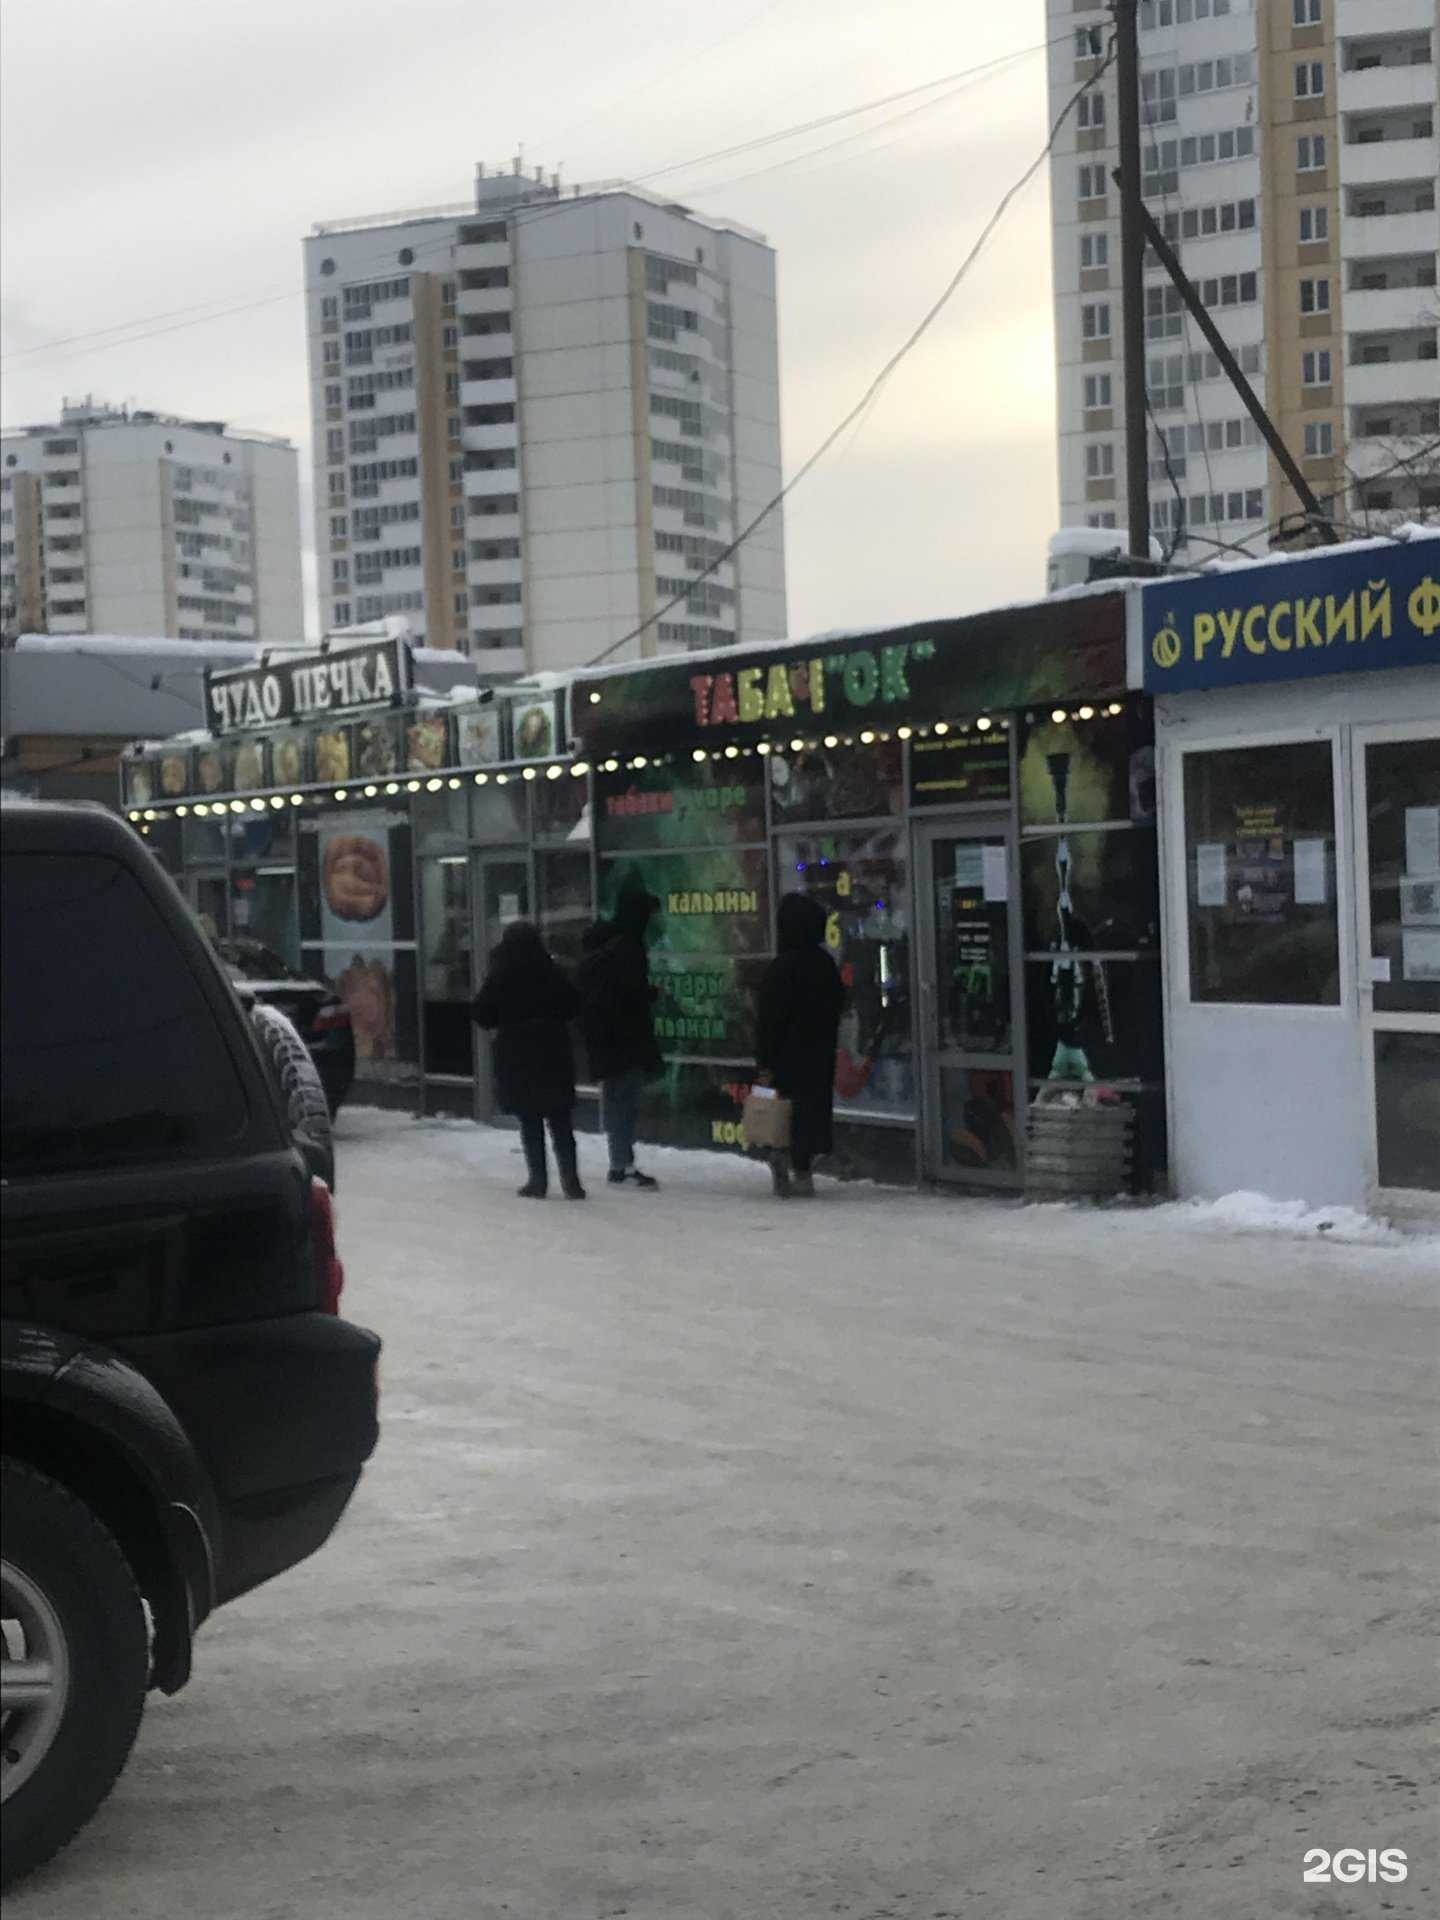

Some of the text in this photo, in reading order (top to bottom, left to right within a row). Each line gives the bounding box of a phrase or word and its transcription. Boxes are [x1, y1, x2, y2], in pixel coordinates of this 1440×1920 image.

[1193, 577, 1392, 661] РУССКИЙ
[211, 652, 394, 732] ЧУДО ПЕЧКА
